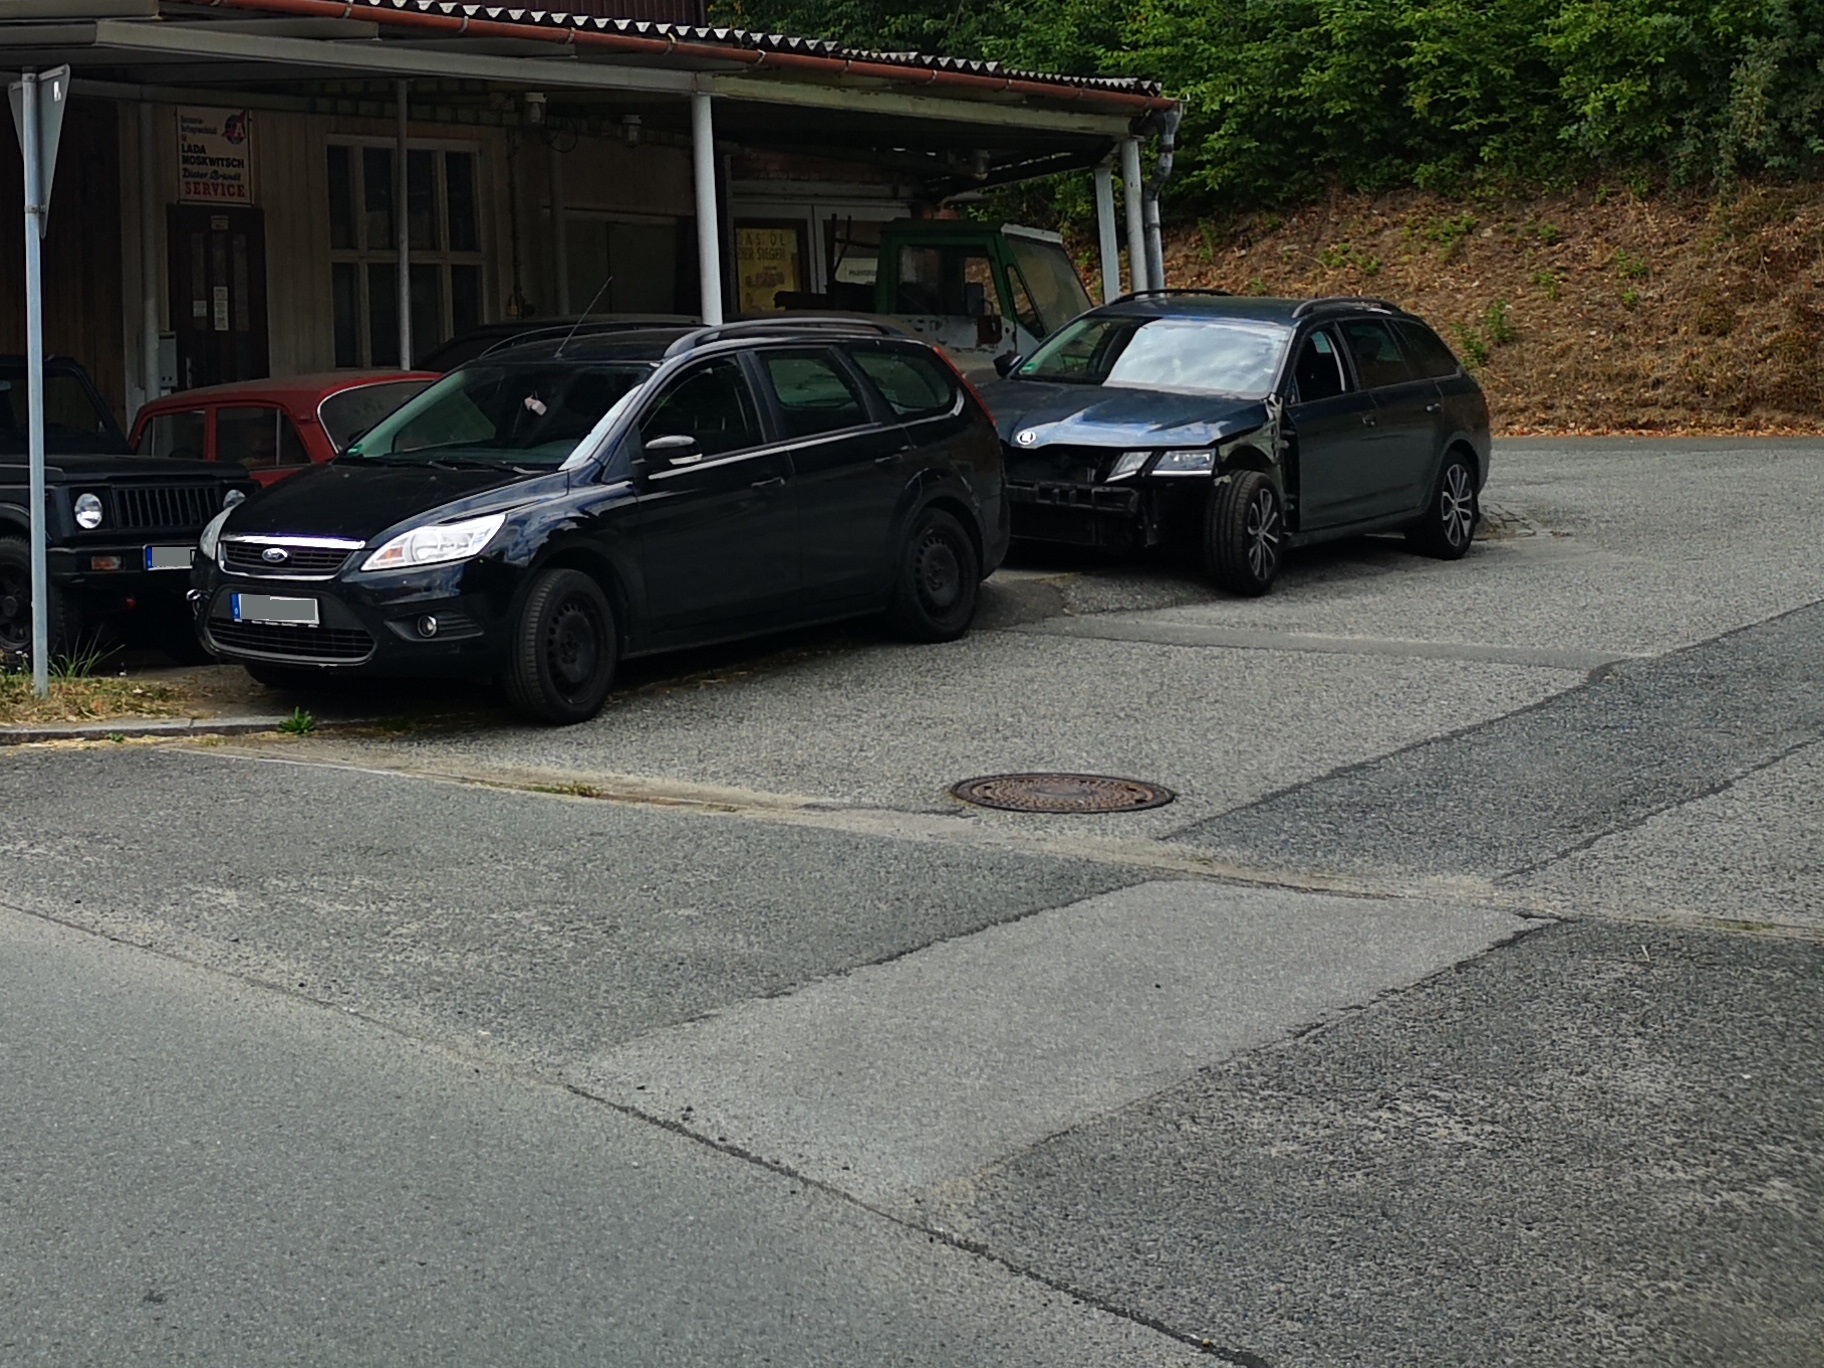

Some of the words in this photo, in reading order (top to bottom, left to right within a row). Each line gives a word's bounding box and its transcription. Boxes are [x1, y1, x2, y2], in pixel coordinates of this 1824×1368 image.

[181, 142, 207, 155] LADA
[181, 154, 245, 169] MOSKWITSCH
[184, 181, 246, 197] SERVICE
